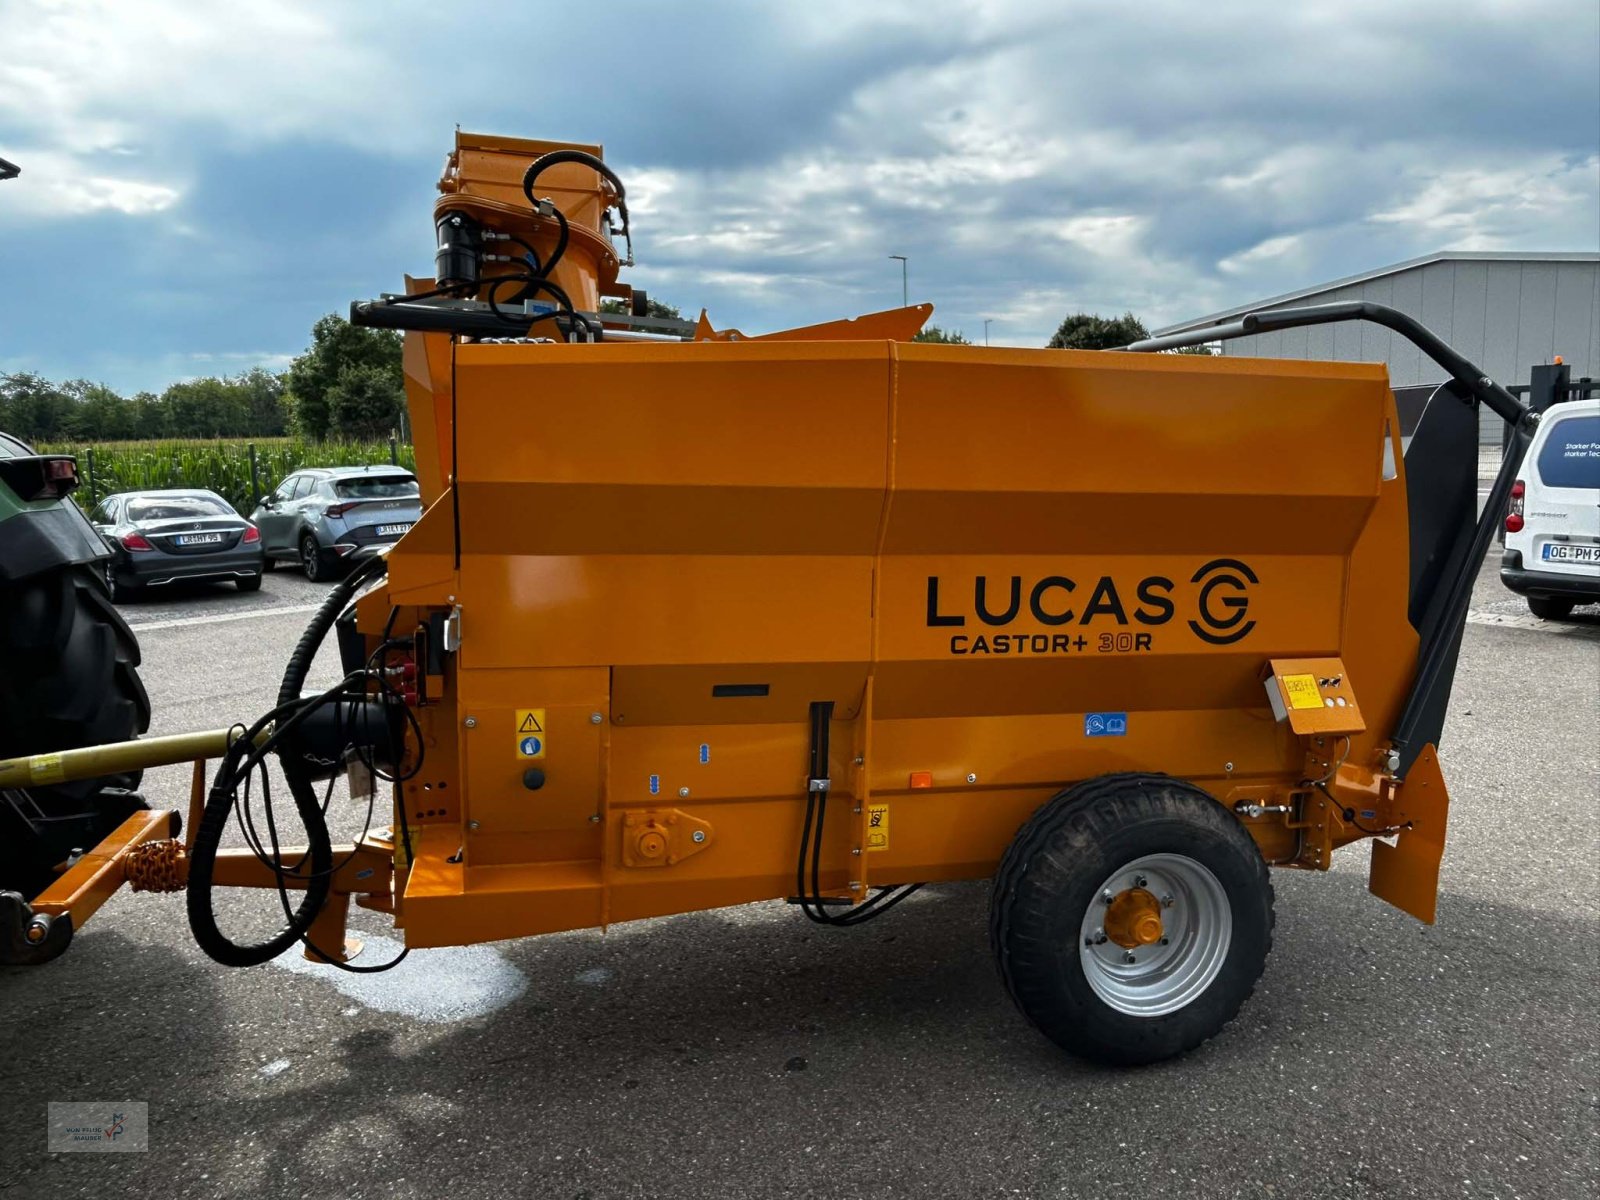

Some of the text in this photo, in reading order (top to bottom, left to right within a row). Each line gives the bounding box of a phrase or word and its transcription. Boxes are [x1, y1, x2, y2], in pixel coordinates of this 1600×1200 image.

[1565, 442, 1590, 450] Starker
[1550, 546, 1568, 558] OG
[1575, 547, 1592, 560] PM
[926, 575, 1175, 627] LUCAS
[950, 632, 1153, 655] CASTOR+ 30R
